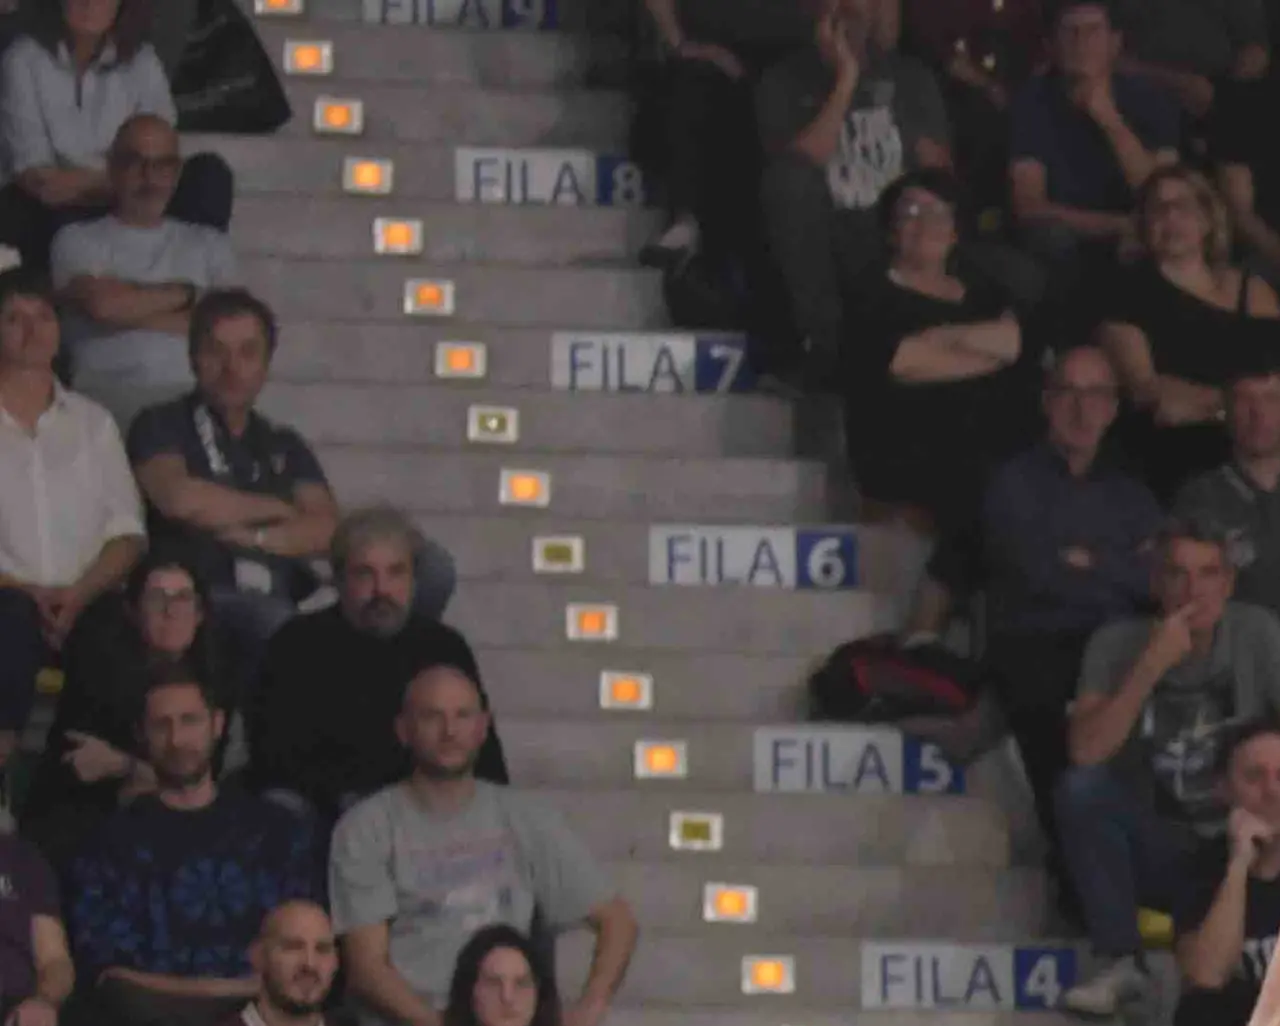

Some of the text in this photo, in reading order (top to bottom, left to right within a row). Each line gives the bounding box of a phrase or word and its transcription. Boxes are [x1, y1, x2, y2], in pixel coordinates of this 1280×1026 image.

[474, 157, 643, 206] FILA 8
[569, 340, 744, 394] FILA 7
[667, 535, 845, 587] FILA 6
[772, 739, 953, 792] FILA 5
[881, 953, 1062, 1008] FILA 4
